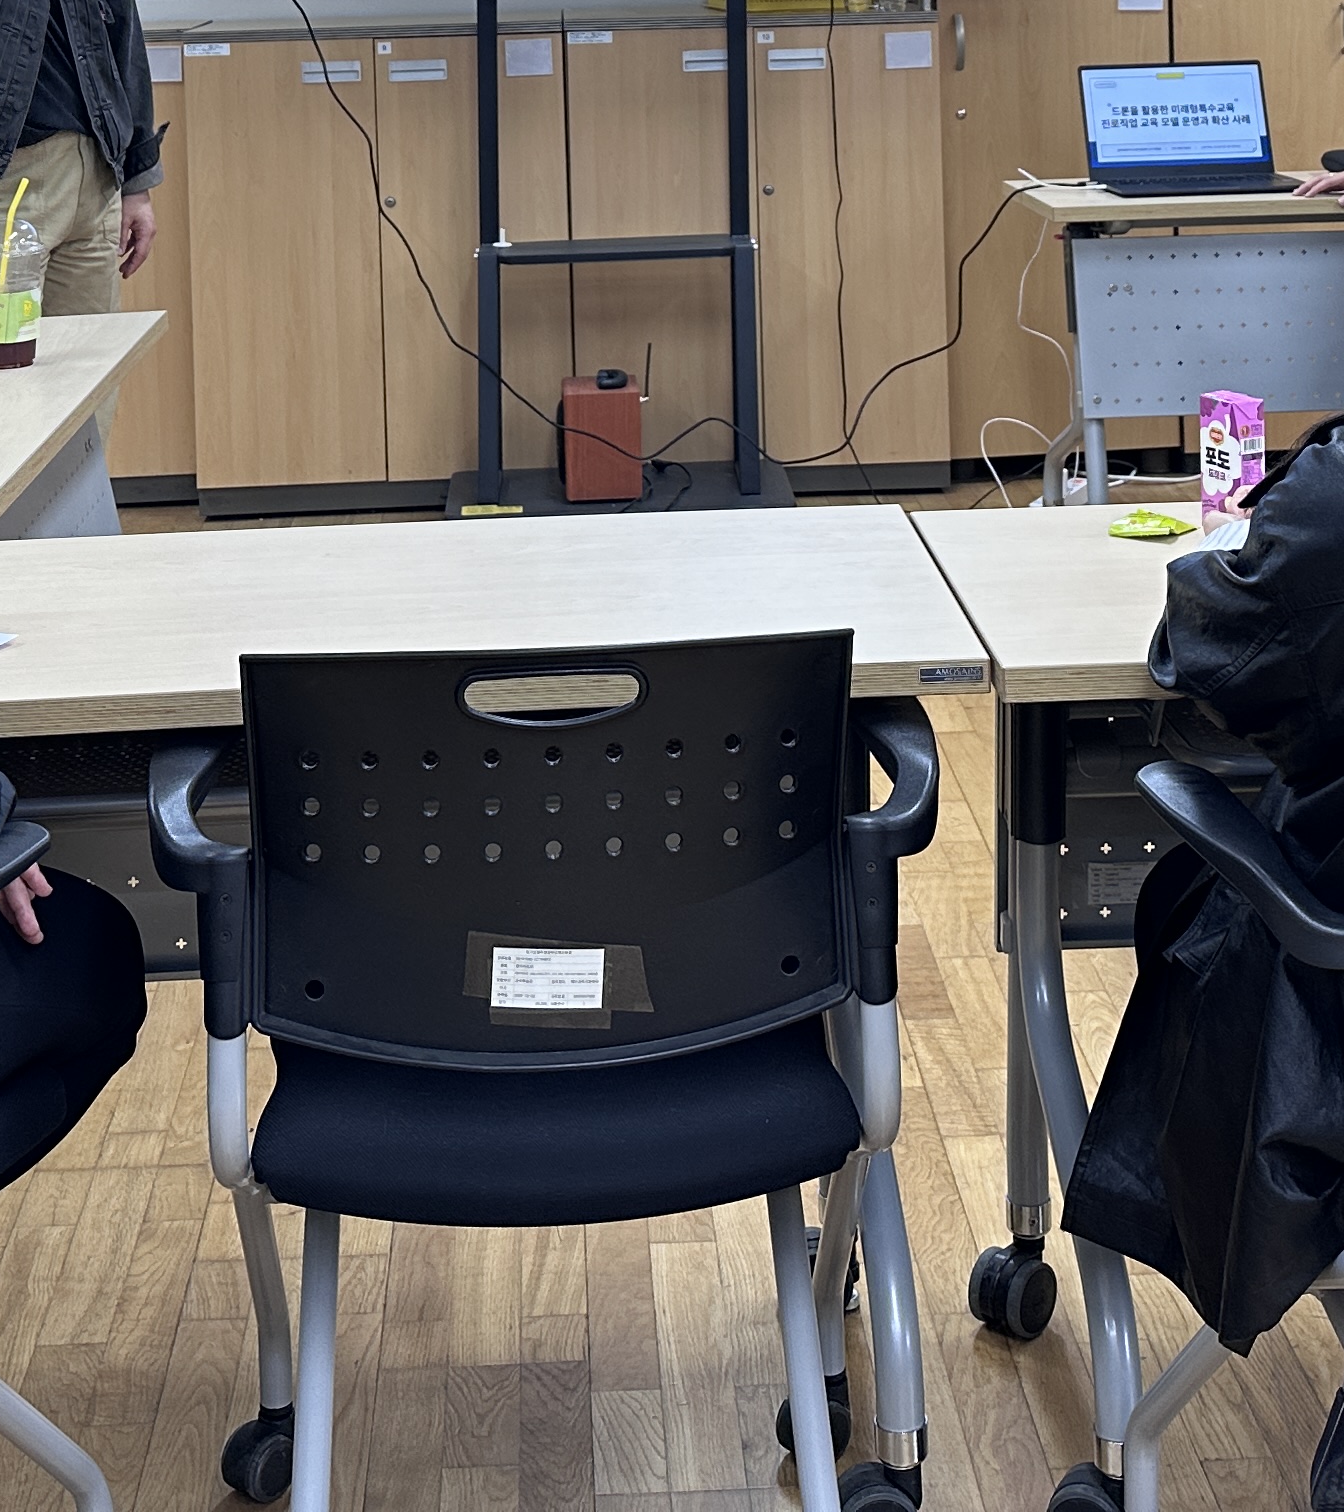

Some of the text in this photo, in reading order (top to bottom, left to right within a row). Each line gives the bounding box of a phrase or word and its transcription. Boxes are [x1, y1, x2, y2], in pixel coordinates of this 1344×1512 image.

[1140, 117, 1159, 128] 교육
[1232, 114, 1251, 125] 사례
[1205, 445, 1231, 471] 포도
